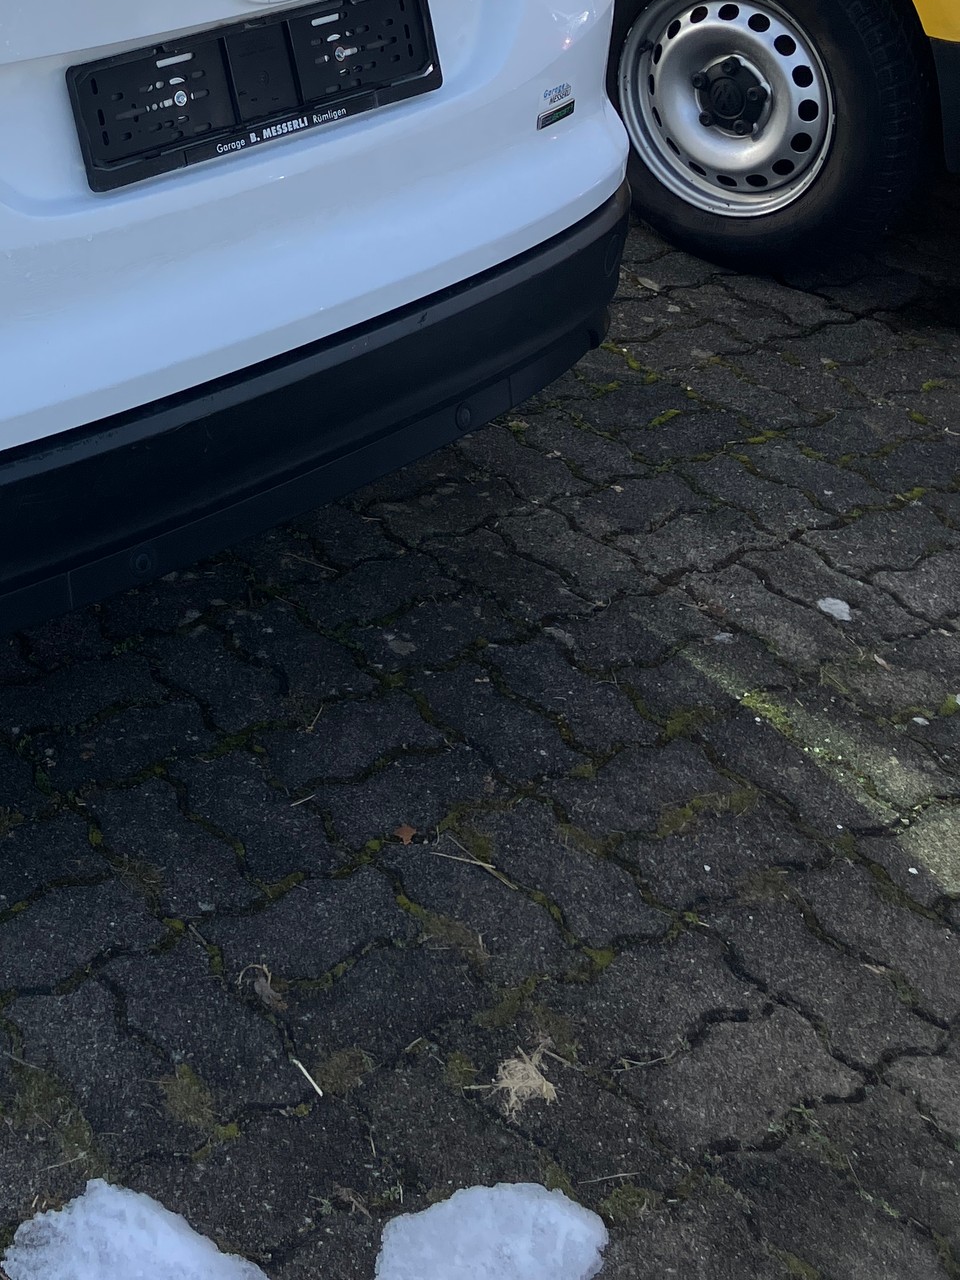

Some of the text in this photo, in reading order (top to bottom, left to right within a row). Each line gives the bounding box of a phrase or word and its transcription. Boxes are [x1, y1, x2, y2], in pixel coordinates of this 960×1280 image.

[216, 107, 347, 153] Garage B. MESSERLI Rümligen
